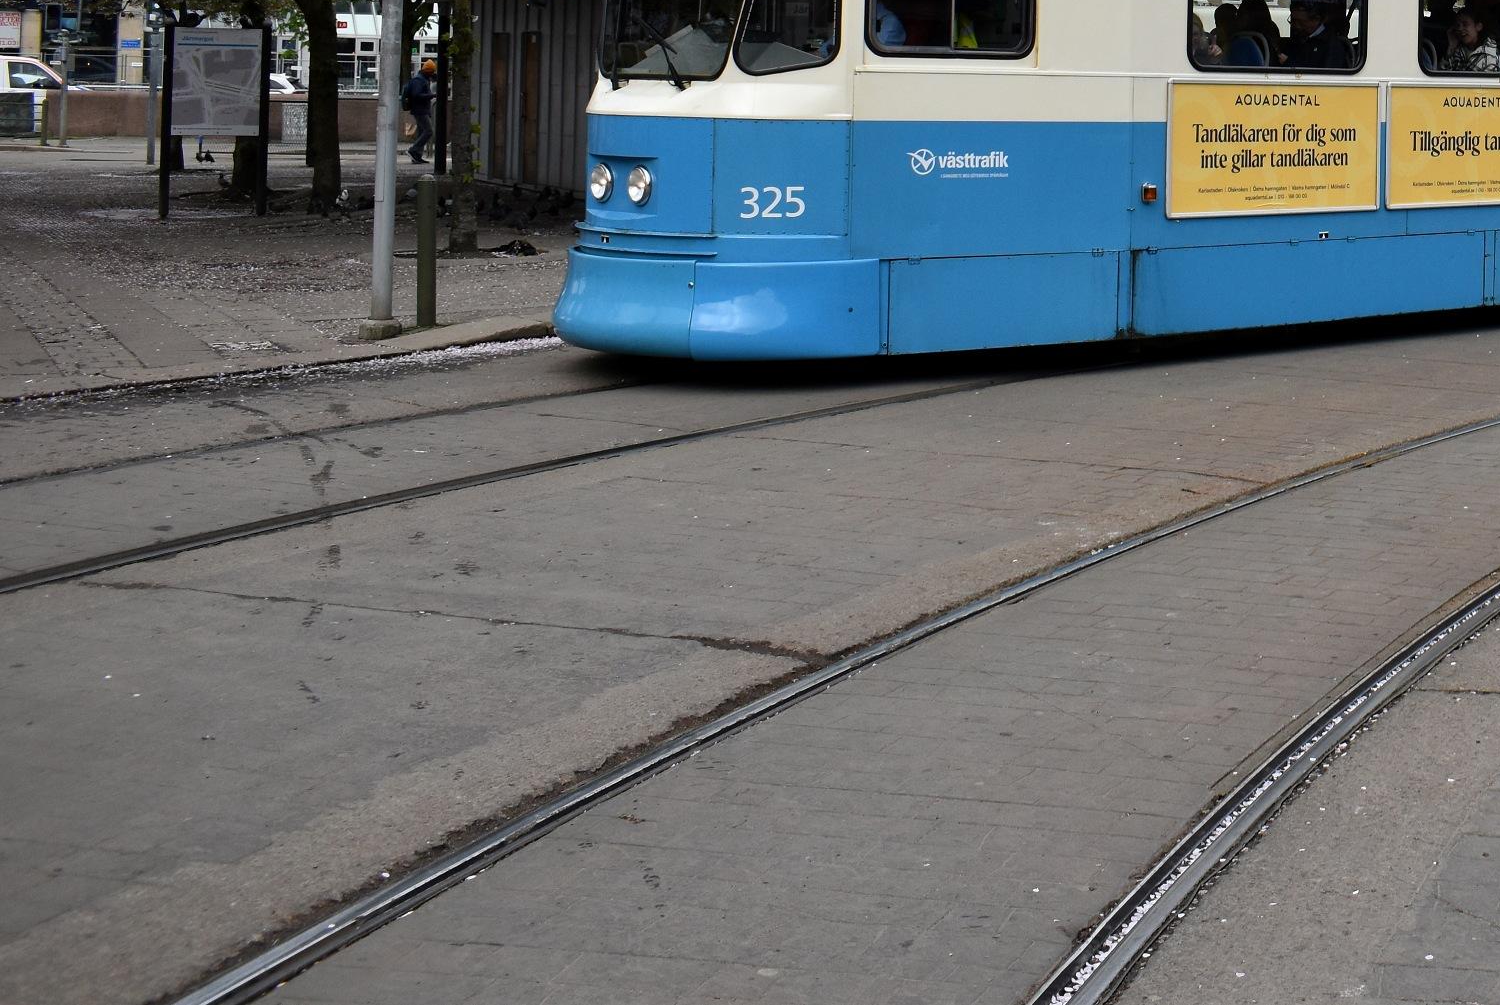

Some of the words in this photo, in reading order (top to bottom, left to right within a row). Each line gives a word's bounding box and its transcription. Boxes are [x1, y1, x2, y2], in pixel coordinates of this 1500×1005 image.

[1234, 93, 1321, 107] AQUADENTAL
[1192, 123, 1278, 143] Tandläkaren
[1282, 123, 1302, 143] för
[1305, 123, 1326, 147] dig
[1330, 127, 1356, 142] som
[1410, 130, 1481, 157] Tillgänglig
[938, 151, 1009, 169] västtrafik
[1201, 149, 1228, 169] inte
[1231, 149, 1266, 173] gillar
[1270, 148, 1349, 168] tandläkaren
[740, 186, 806, 219] 325
